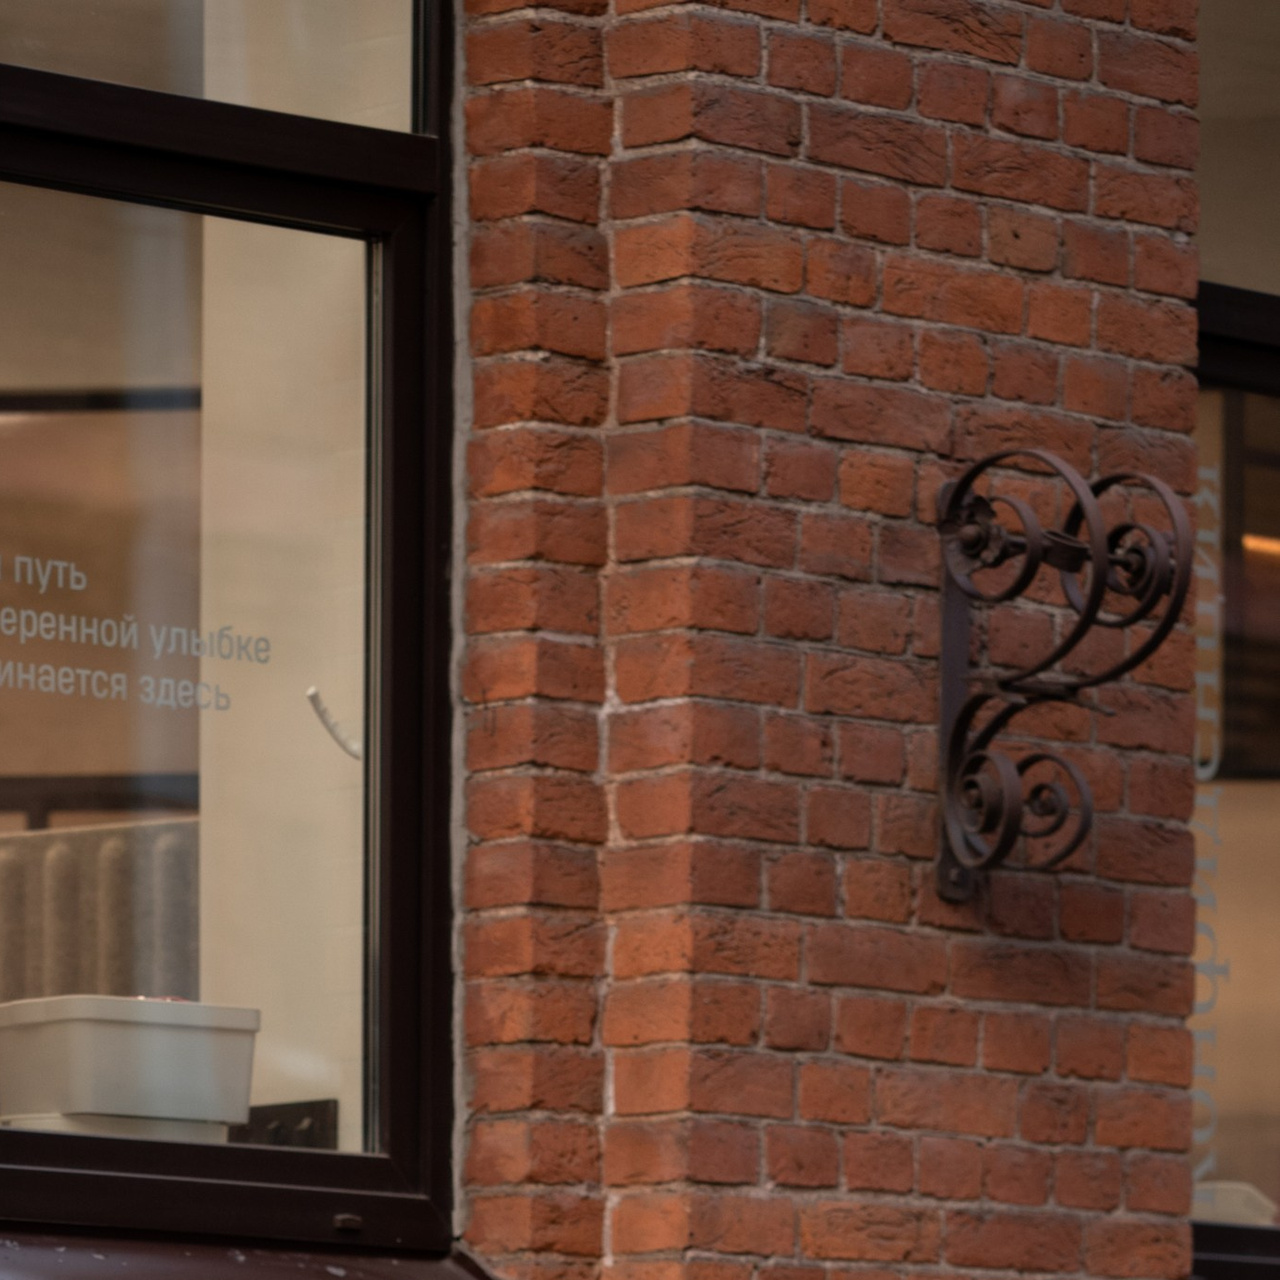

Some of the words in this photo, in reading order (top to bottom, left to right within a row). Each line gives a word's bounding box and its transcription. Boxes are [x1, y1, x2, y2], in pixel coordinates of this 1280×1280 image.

[14, 554, 88, 595] путь
[149, 623, 272, 662] улыбке
[138, 674, 232, 712] здесь
